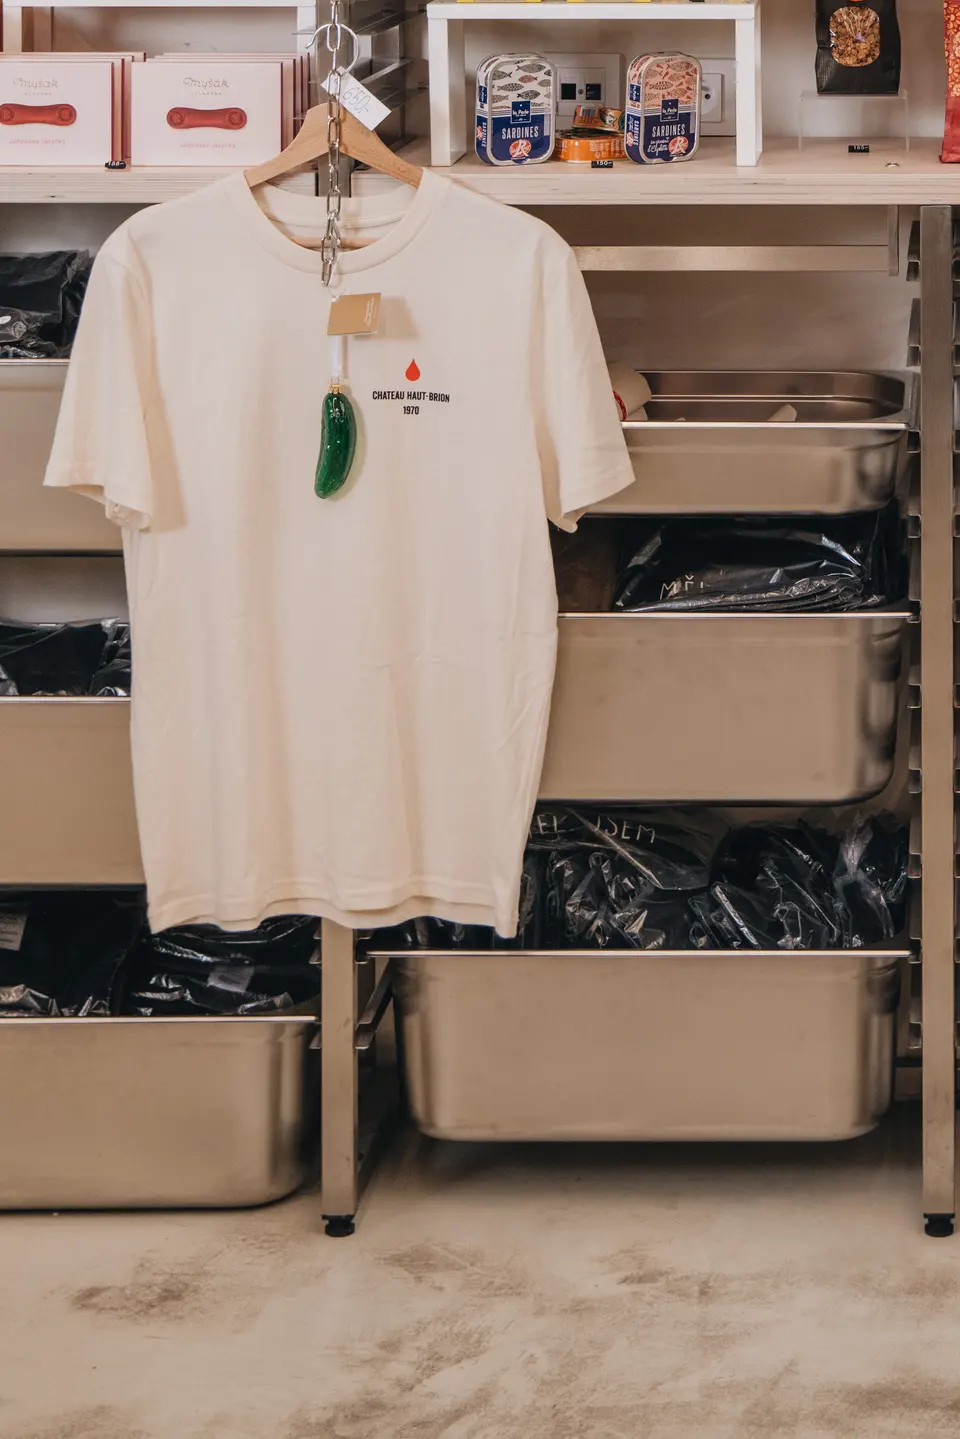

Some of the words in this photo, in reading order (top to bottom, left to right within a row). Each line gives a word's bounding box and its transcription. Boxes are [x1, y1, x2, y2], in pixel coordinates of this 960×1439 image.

[502, 126, 539, 139] SARDINES
[652, 124, 686, 137] SARDINES
[372, 391, 405, 400] CHATEAU
[407, 391, 450, 403] HAUT-BRION
[403, 406, 420, 415] 1970
